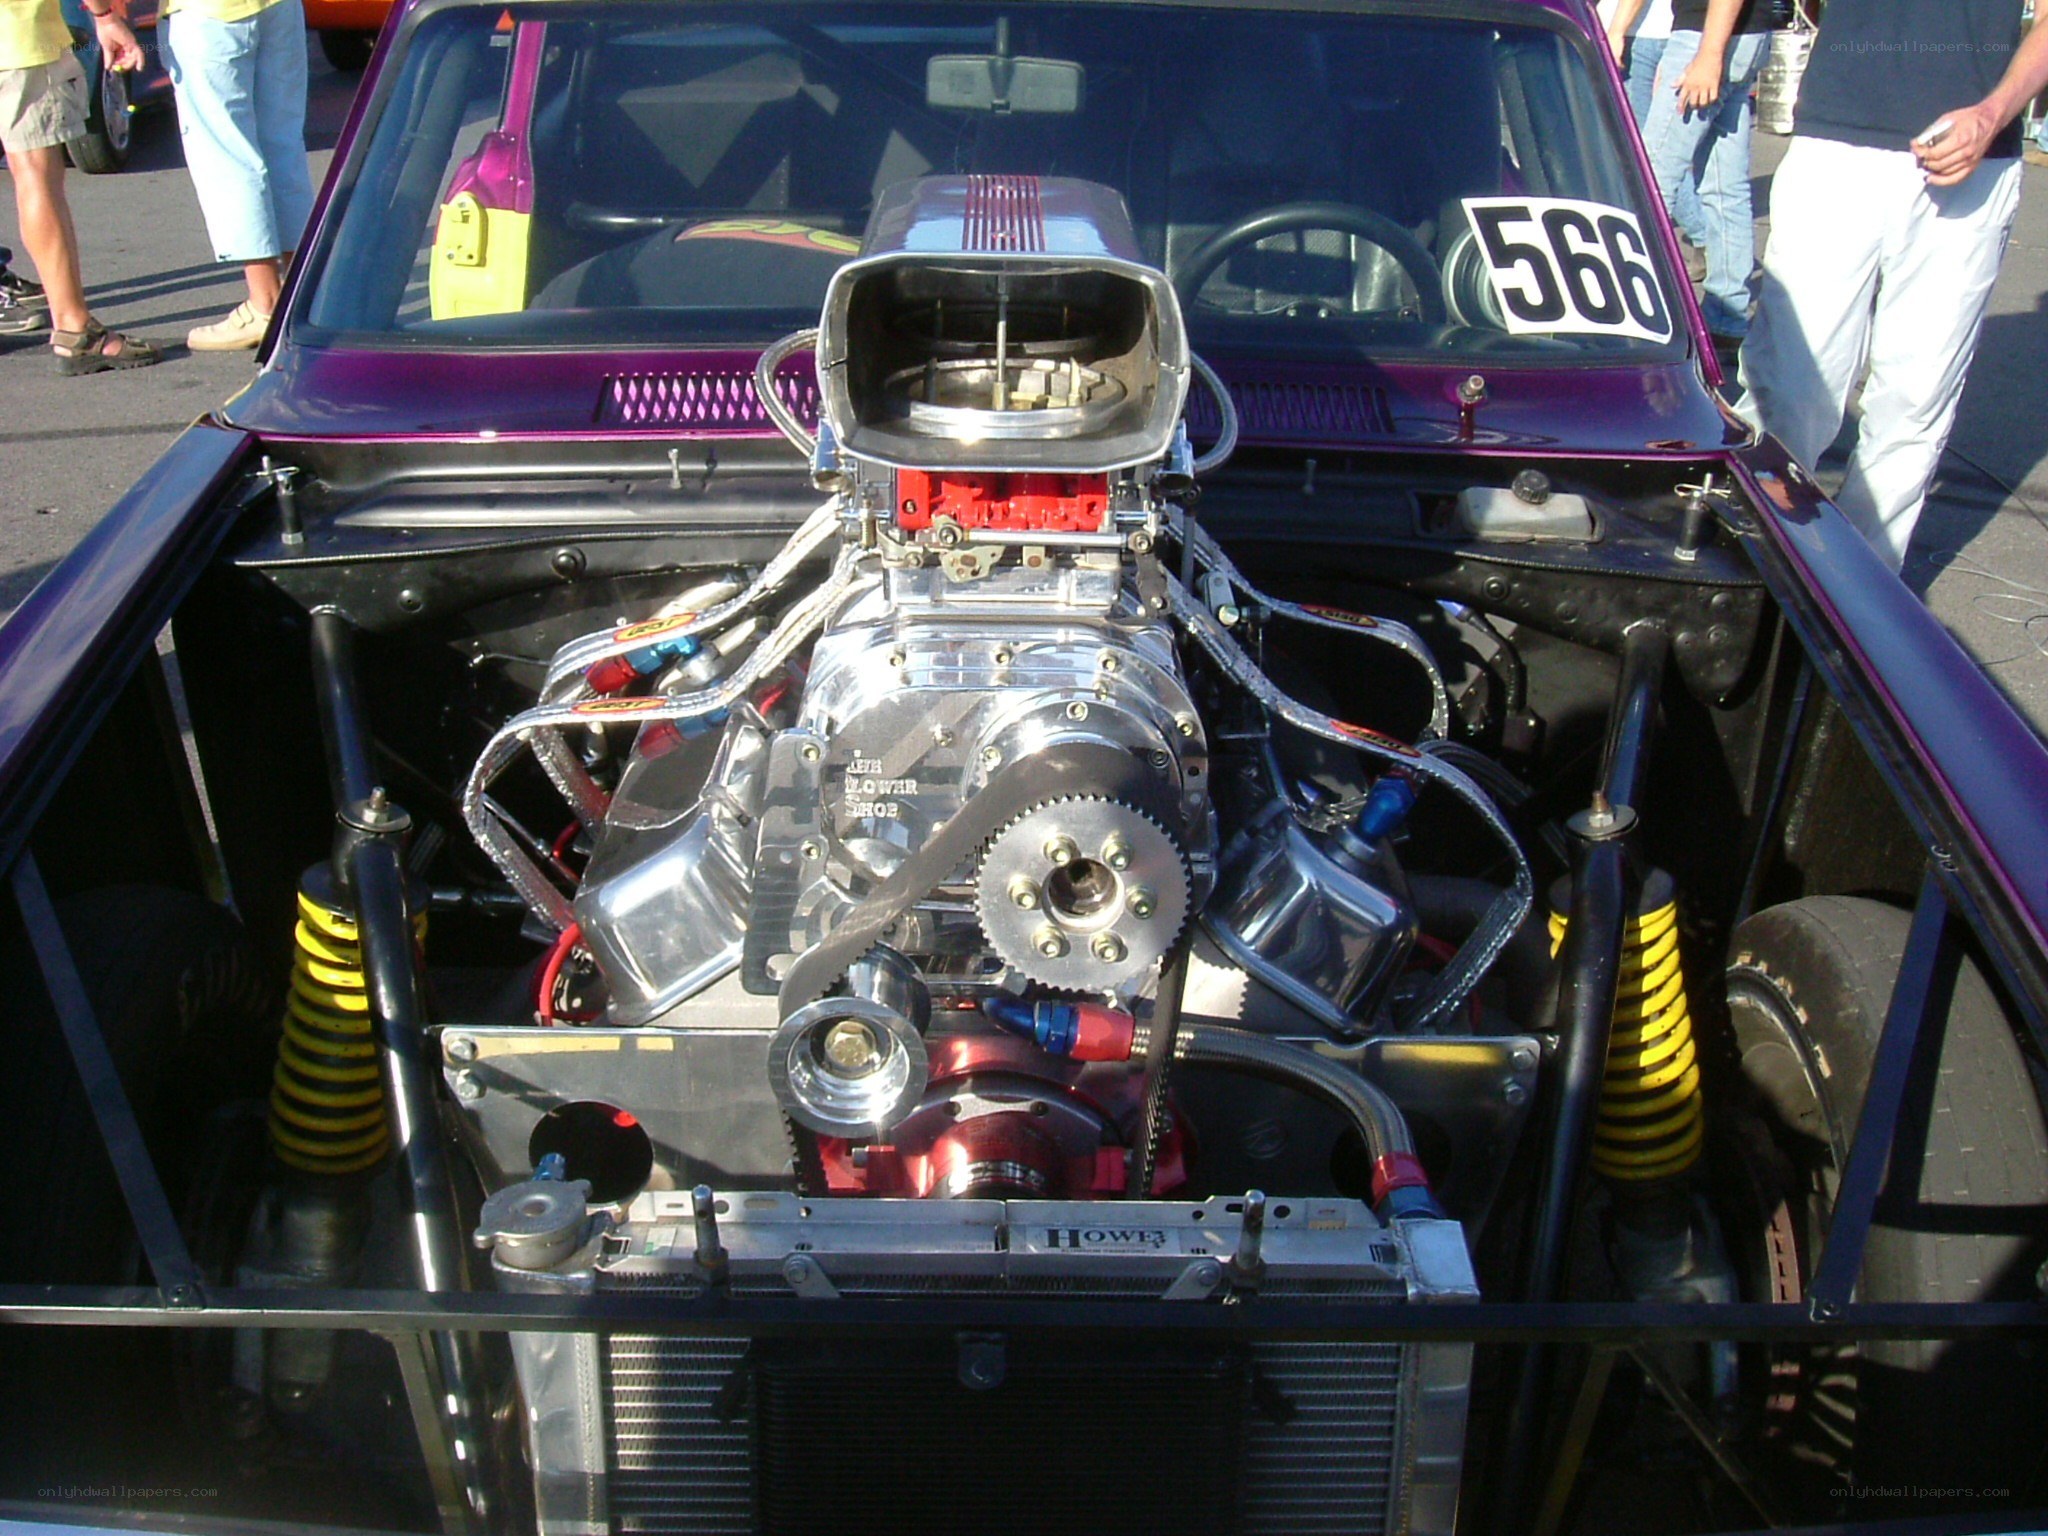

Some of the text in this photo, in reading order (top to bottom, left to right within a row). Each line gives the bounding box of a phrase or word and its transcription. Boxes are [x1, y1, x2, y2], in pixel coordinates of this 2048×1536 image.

[1472, 206, 1670, 335] 566
[845, 794, 899, 818] SHOP
[1046, 1228, 1159, 1248] HOWE
